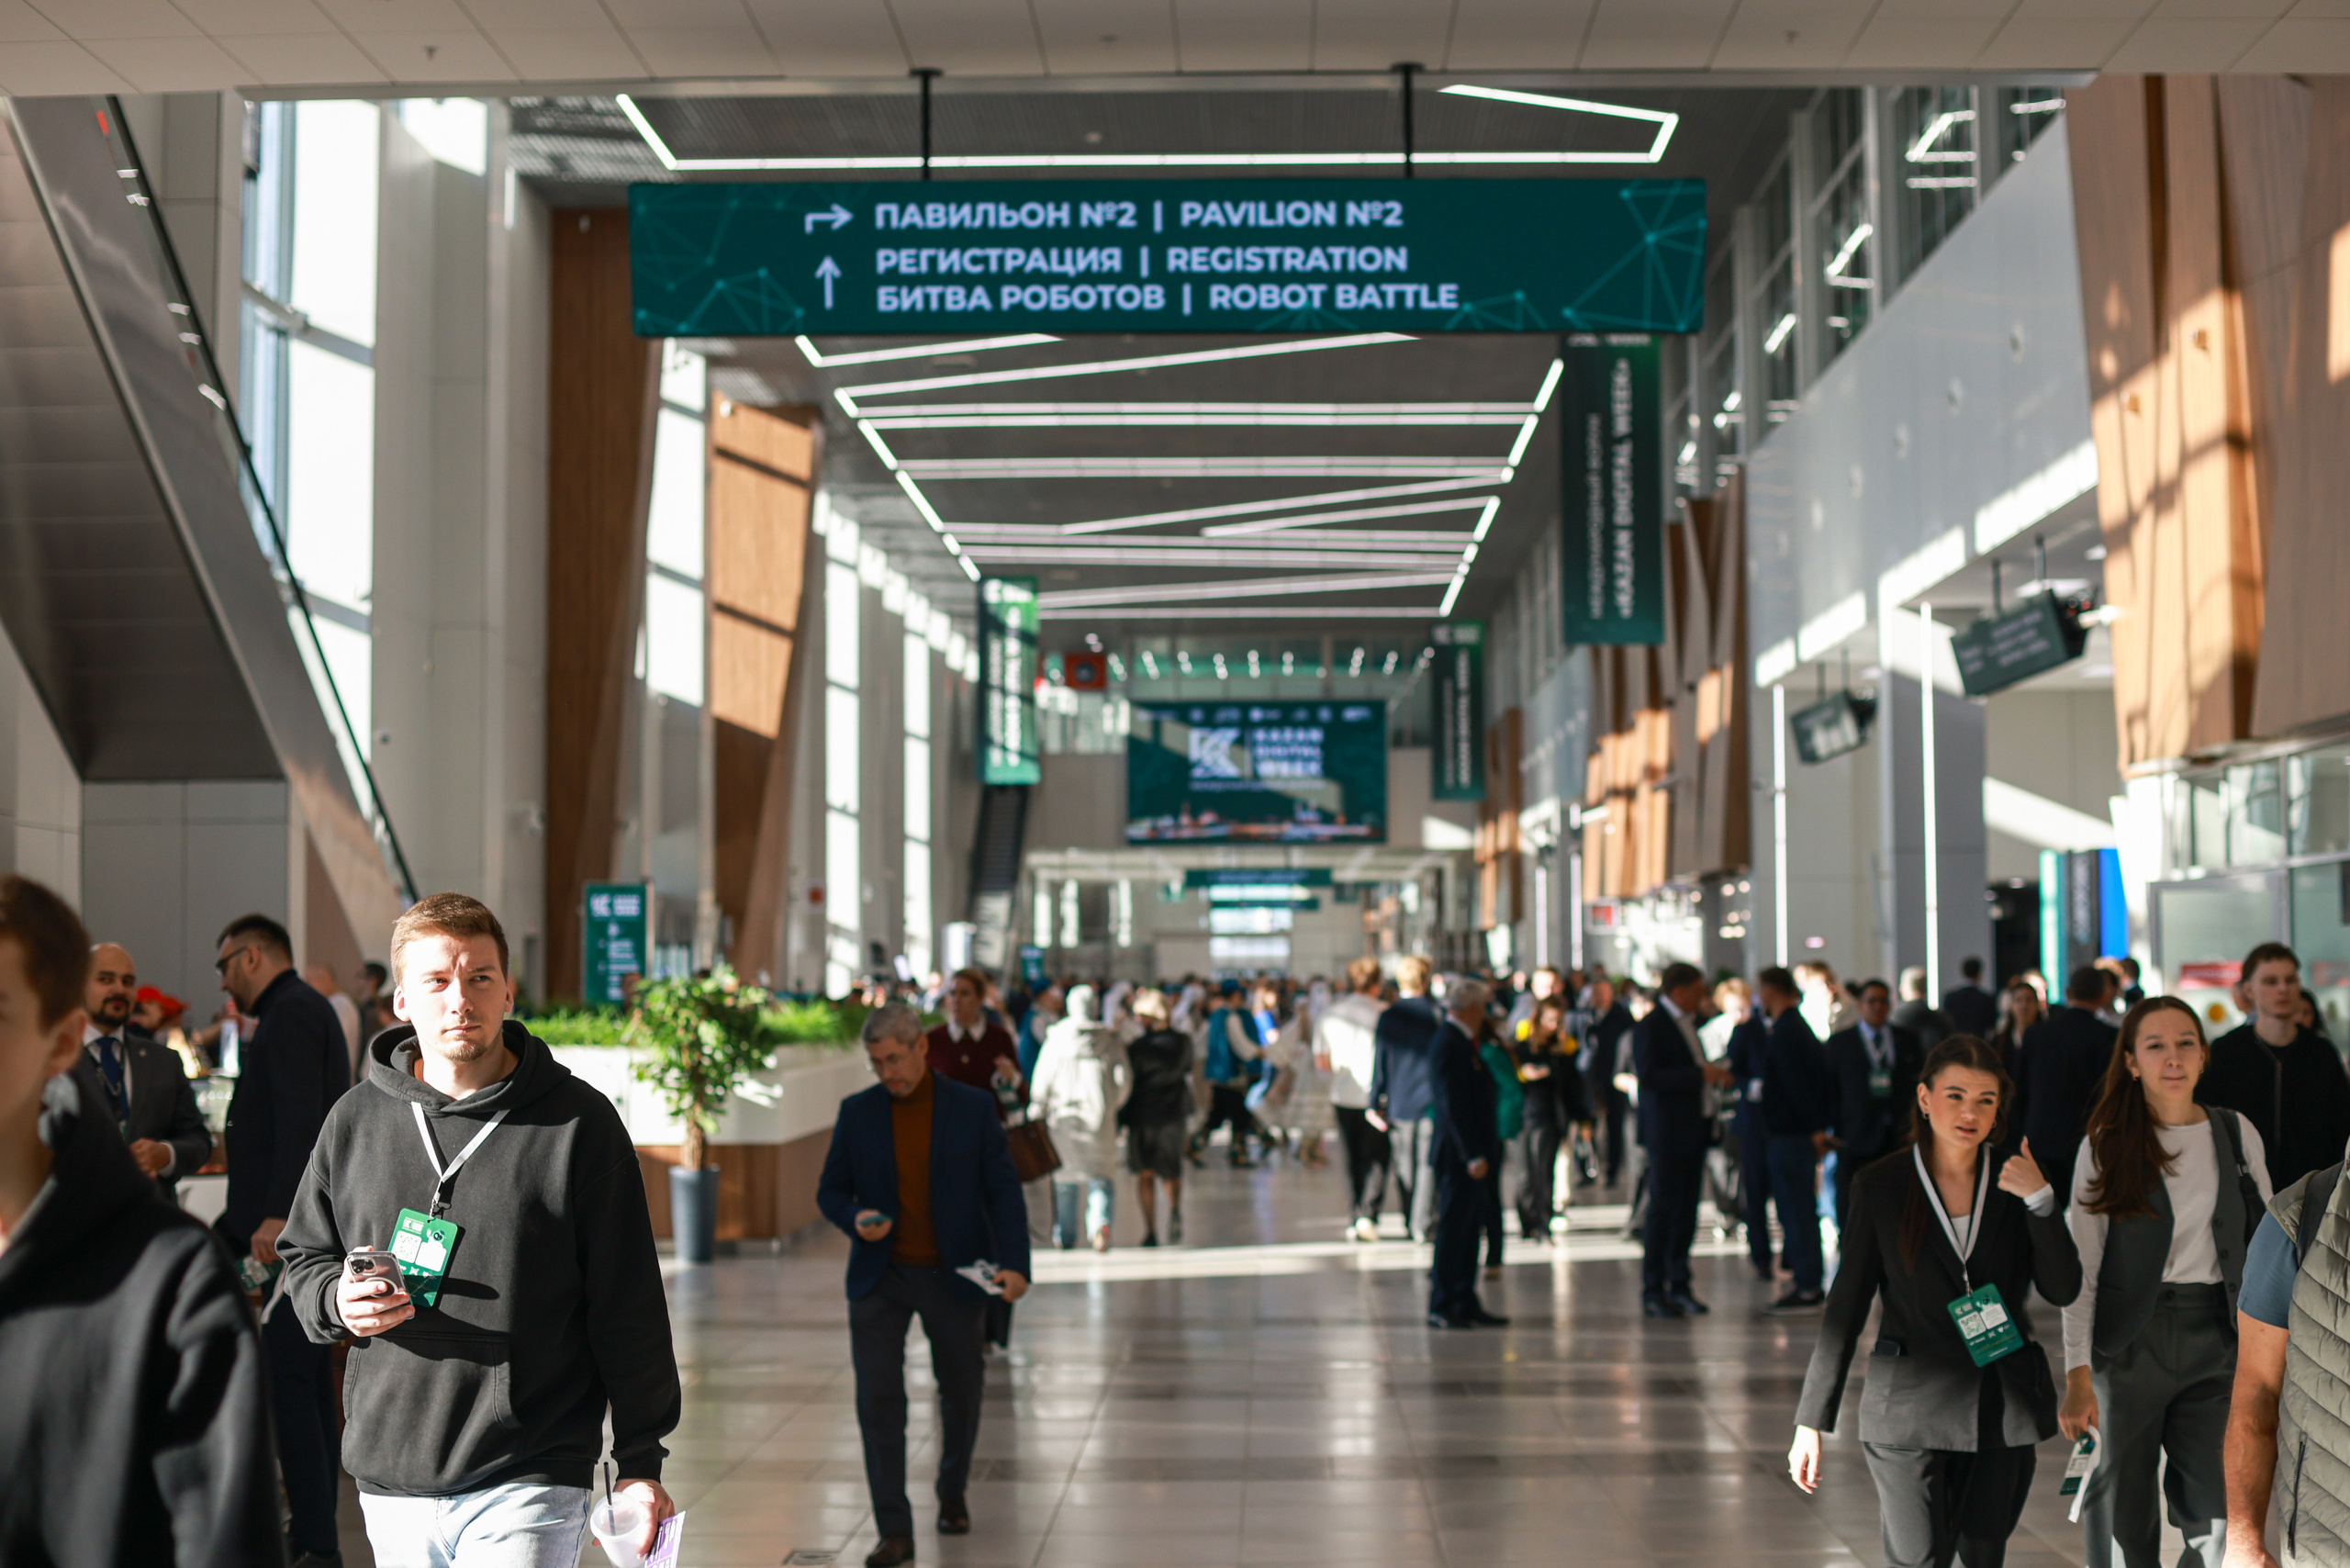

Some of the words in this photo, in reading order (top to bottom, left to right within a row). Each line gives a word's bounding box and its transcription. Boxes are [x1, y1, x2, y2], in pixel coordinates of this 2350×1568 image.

[875, 202, 1070, 229] ПАВИЛЬОН
[1080, 202, 1137, 228] №2
[1181, 201, 1337, 226] PAVILION
[1346, 201, 1404, 226] №2
[877, 246, 1122, 276] РЕГИСТРАЦИЯ
[1167, 246, 1408, 272] REGISTRATION
[877, 285, 992, 311] БИТВА
[1001, 285, 1166, 310] РОБОТОВ
[1210, 284, 1328, 309] ROBOT
[1336, 284, 1460, 309] BATTLE
